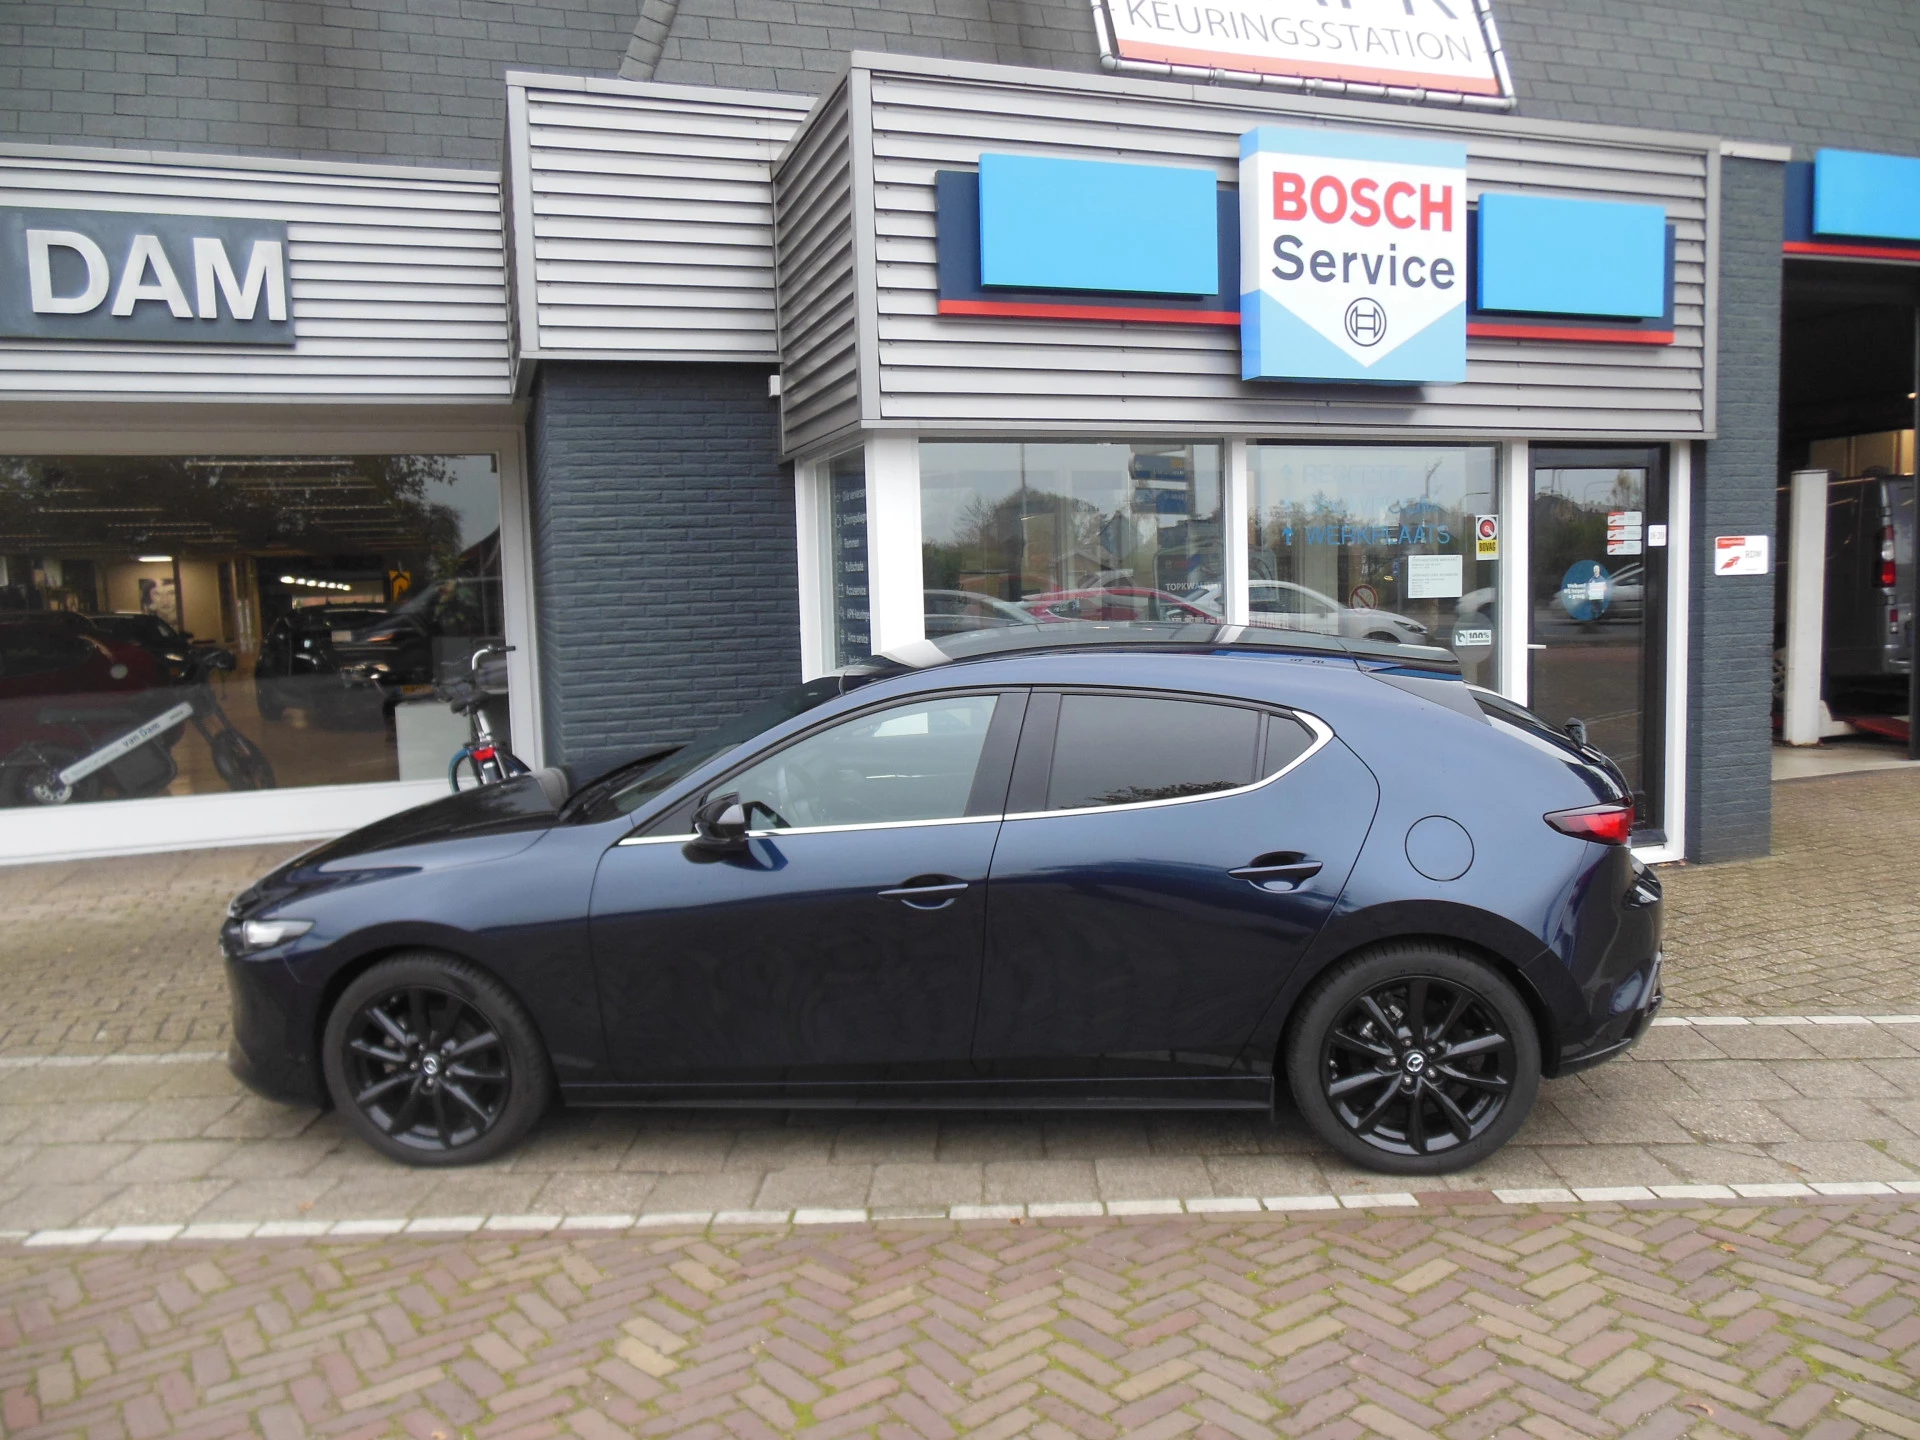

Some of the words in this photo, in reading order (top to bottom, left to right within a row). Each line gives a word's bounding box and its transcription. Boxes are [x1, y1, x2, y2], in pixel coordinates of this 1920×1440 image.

[1127, 0, 1473, 63] KEURINGSSTATION
[1272, 171, 1453, 232] BOSCH
[26, 229, 287, 321] DAM
[1271, 234, 1455, 290] Service
[1304, 524, 1451, 546] WERKPLAATS
[1479, 542, 1496, 552] BOVAG
